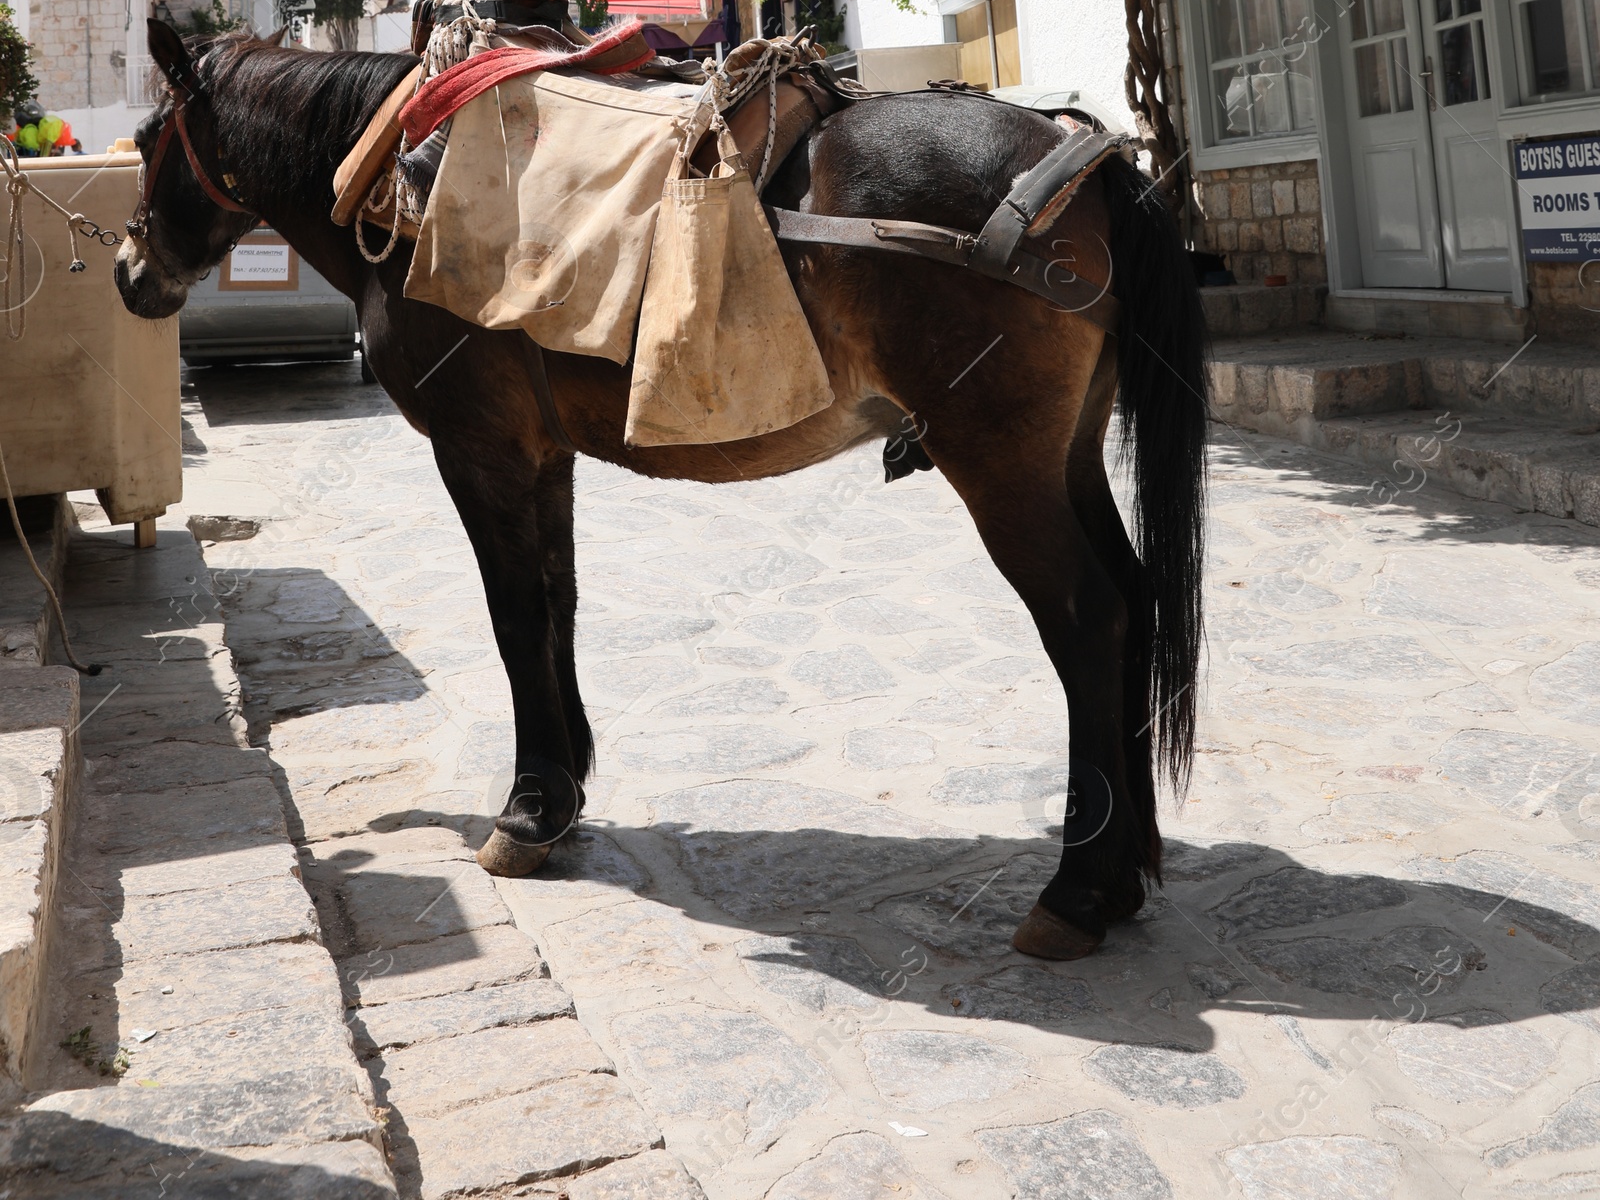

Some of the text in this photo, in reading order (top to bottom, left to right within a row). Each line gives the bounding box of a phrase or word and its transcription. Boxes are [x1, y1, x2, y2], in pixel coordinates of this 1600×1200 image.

[1519, 145, 1563, 172] BOTSIS
[1533, 192, 1590, 213] ROOMS
[1560, 233, 1577, 242] TEL.
[1529, 246, 1579, 255] www.botsis.com
